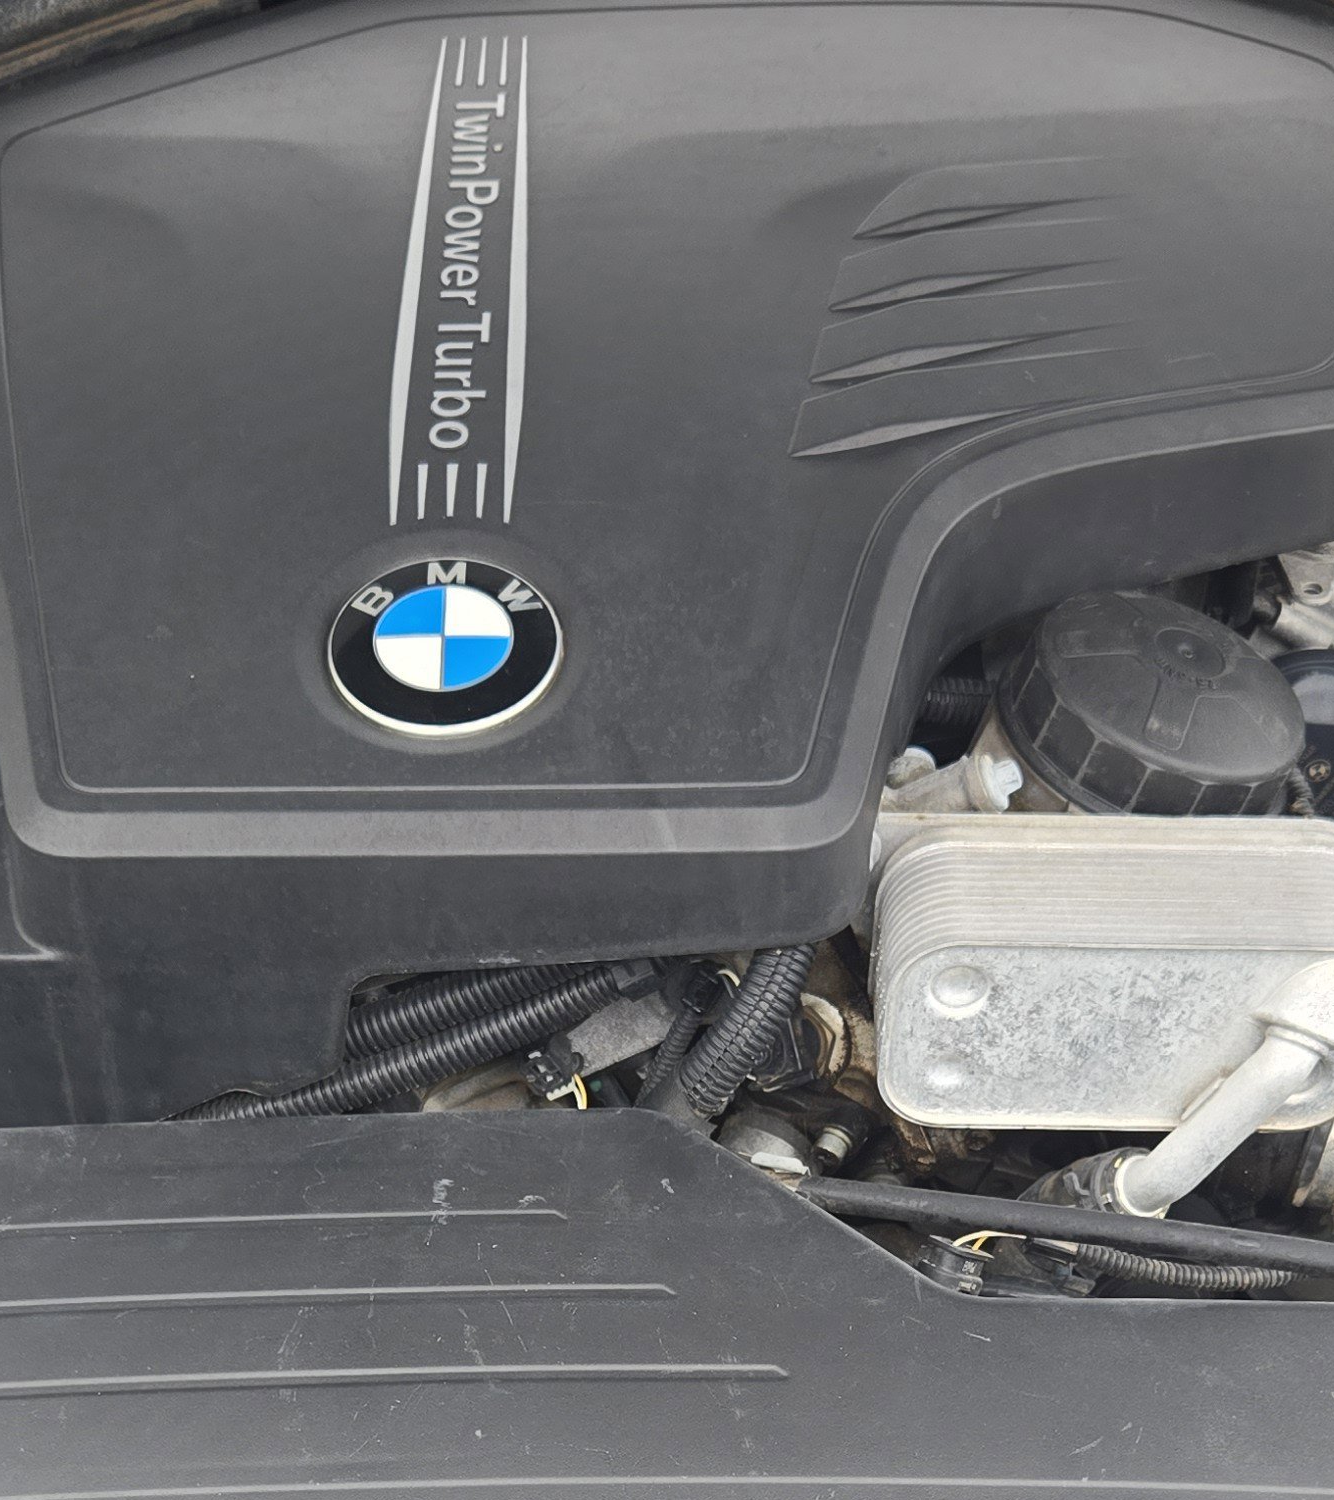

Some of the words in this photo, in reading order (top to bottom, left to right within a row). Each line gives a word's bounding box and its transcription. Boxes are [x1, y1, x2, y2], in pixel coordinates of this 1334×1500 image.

[439, 92, 506, 306] TwinPower
[428, 311, 492, 450] Turbo
[350, 561, 544, 617] BMW
